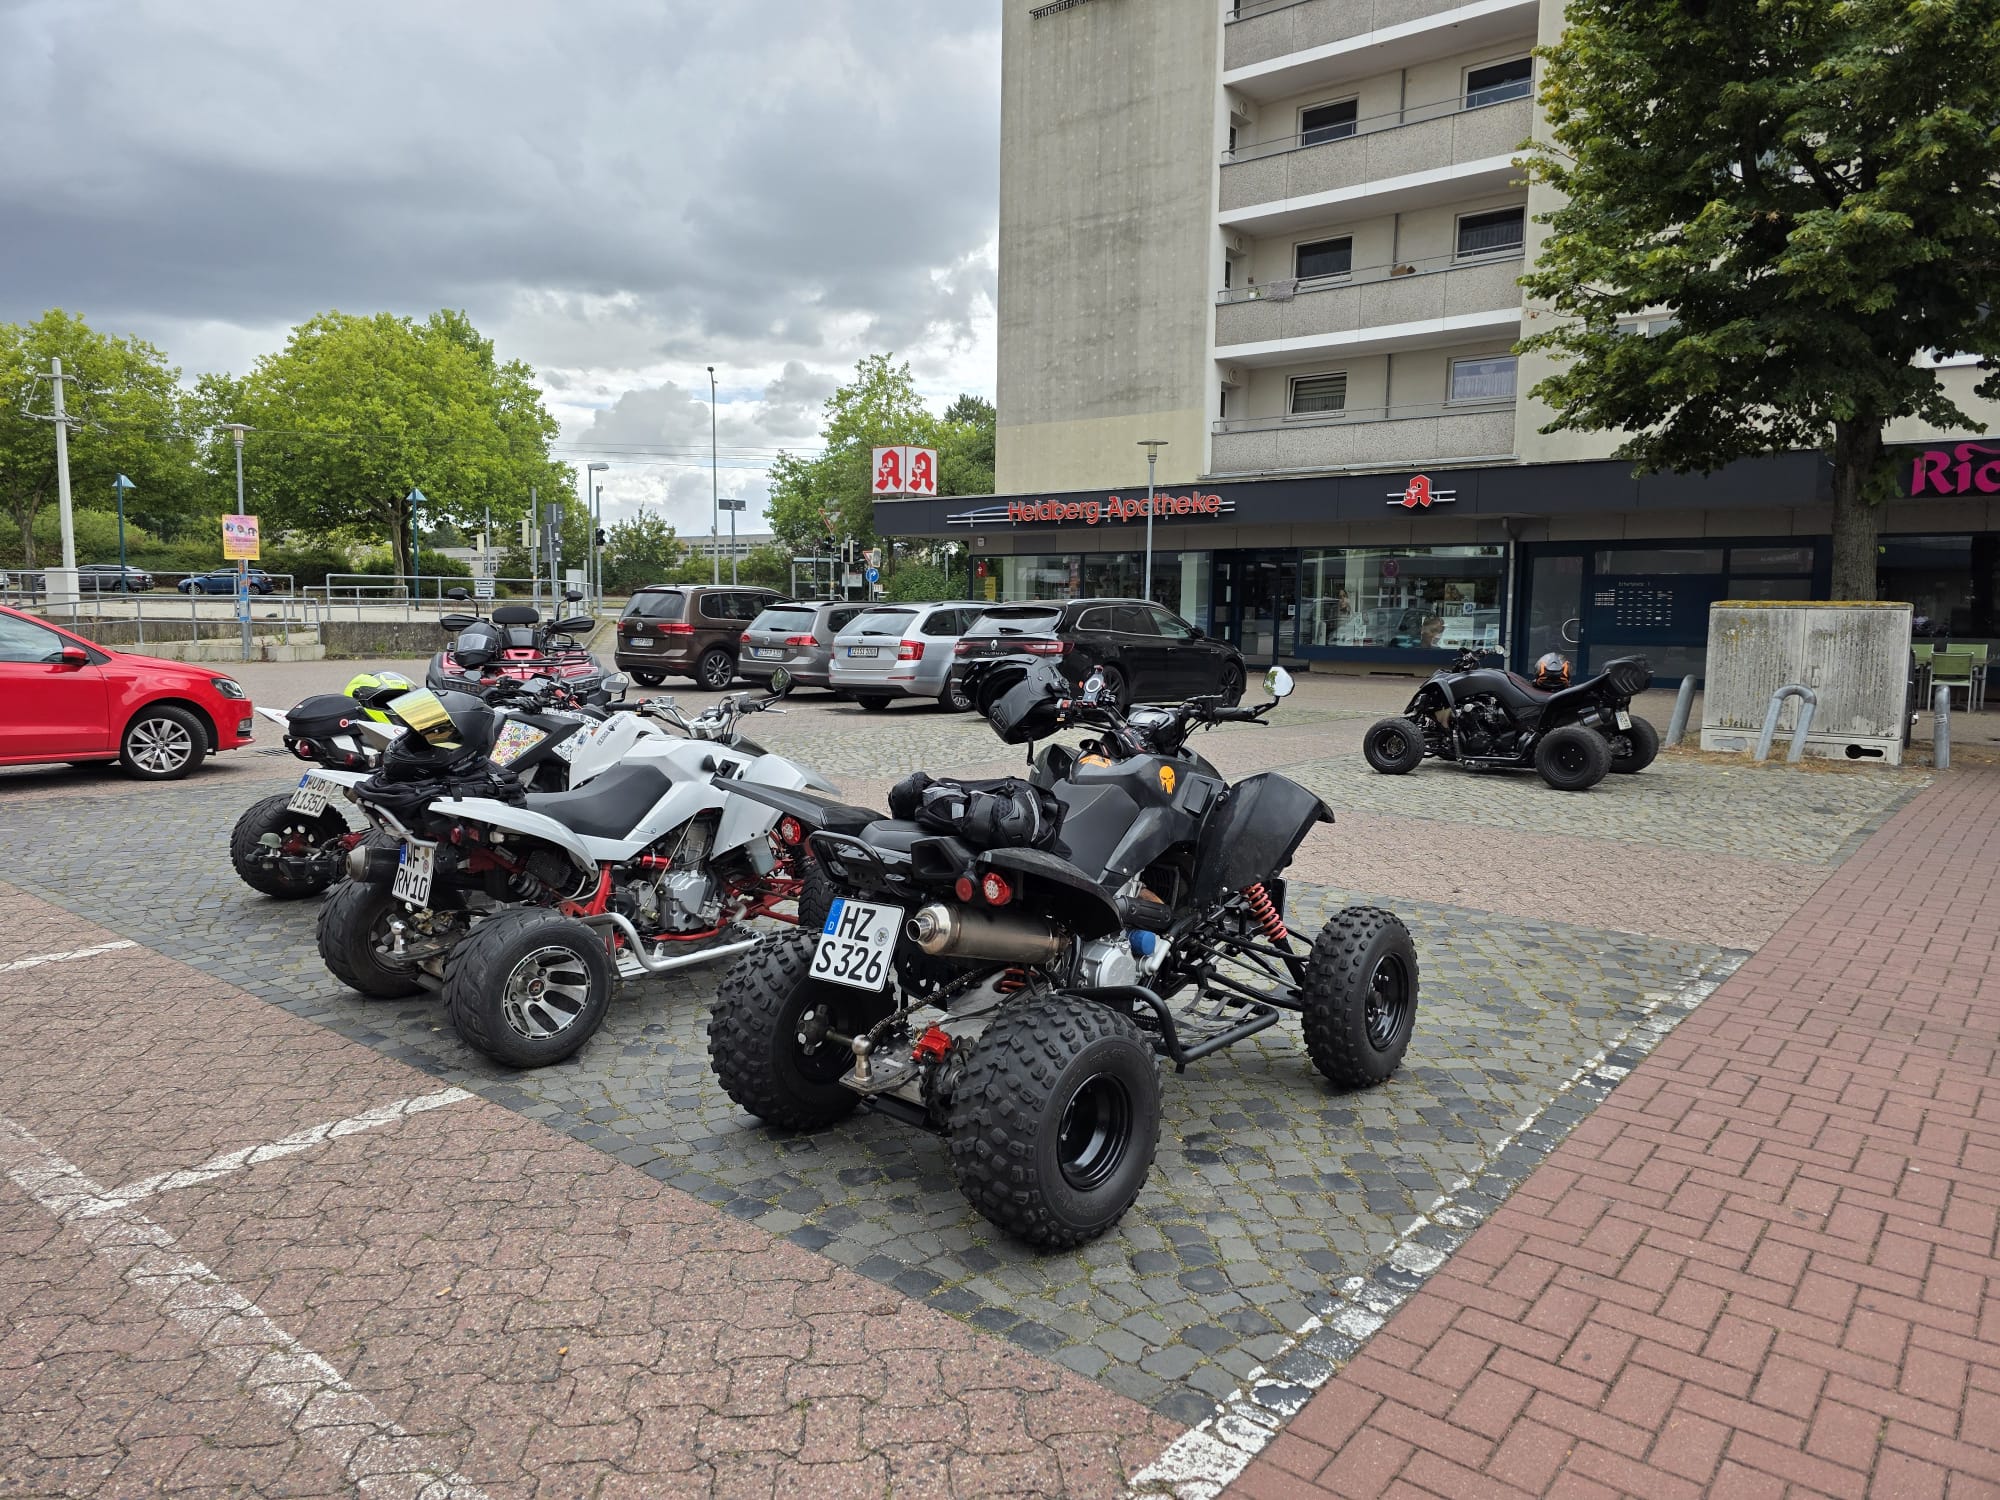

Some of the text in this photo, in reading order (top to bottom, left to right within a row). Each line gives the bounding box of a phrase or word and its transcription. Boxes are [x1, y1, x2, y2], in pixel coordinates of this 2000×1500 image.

[875, 449, 903, 490] A
[909, 451, 934, 492] A
[1008, 491, 1222, 524] Heidberg Apotheke
[1401, 474, 1432, 508] A
[406, 843, 420, 869] WF
[838, 906, 876, 942] HZ
